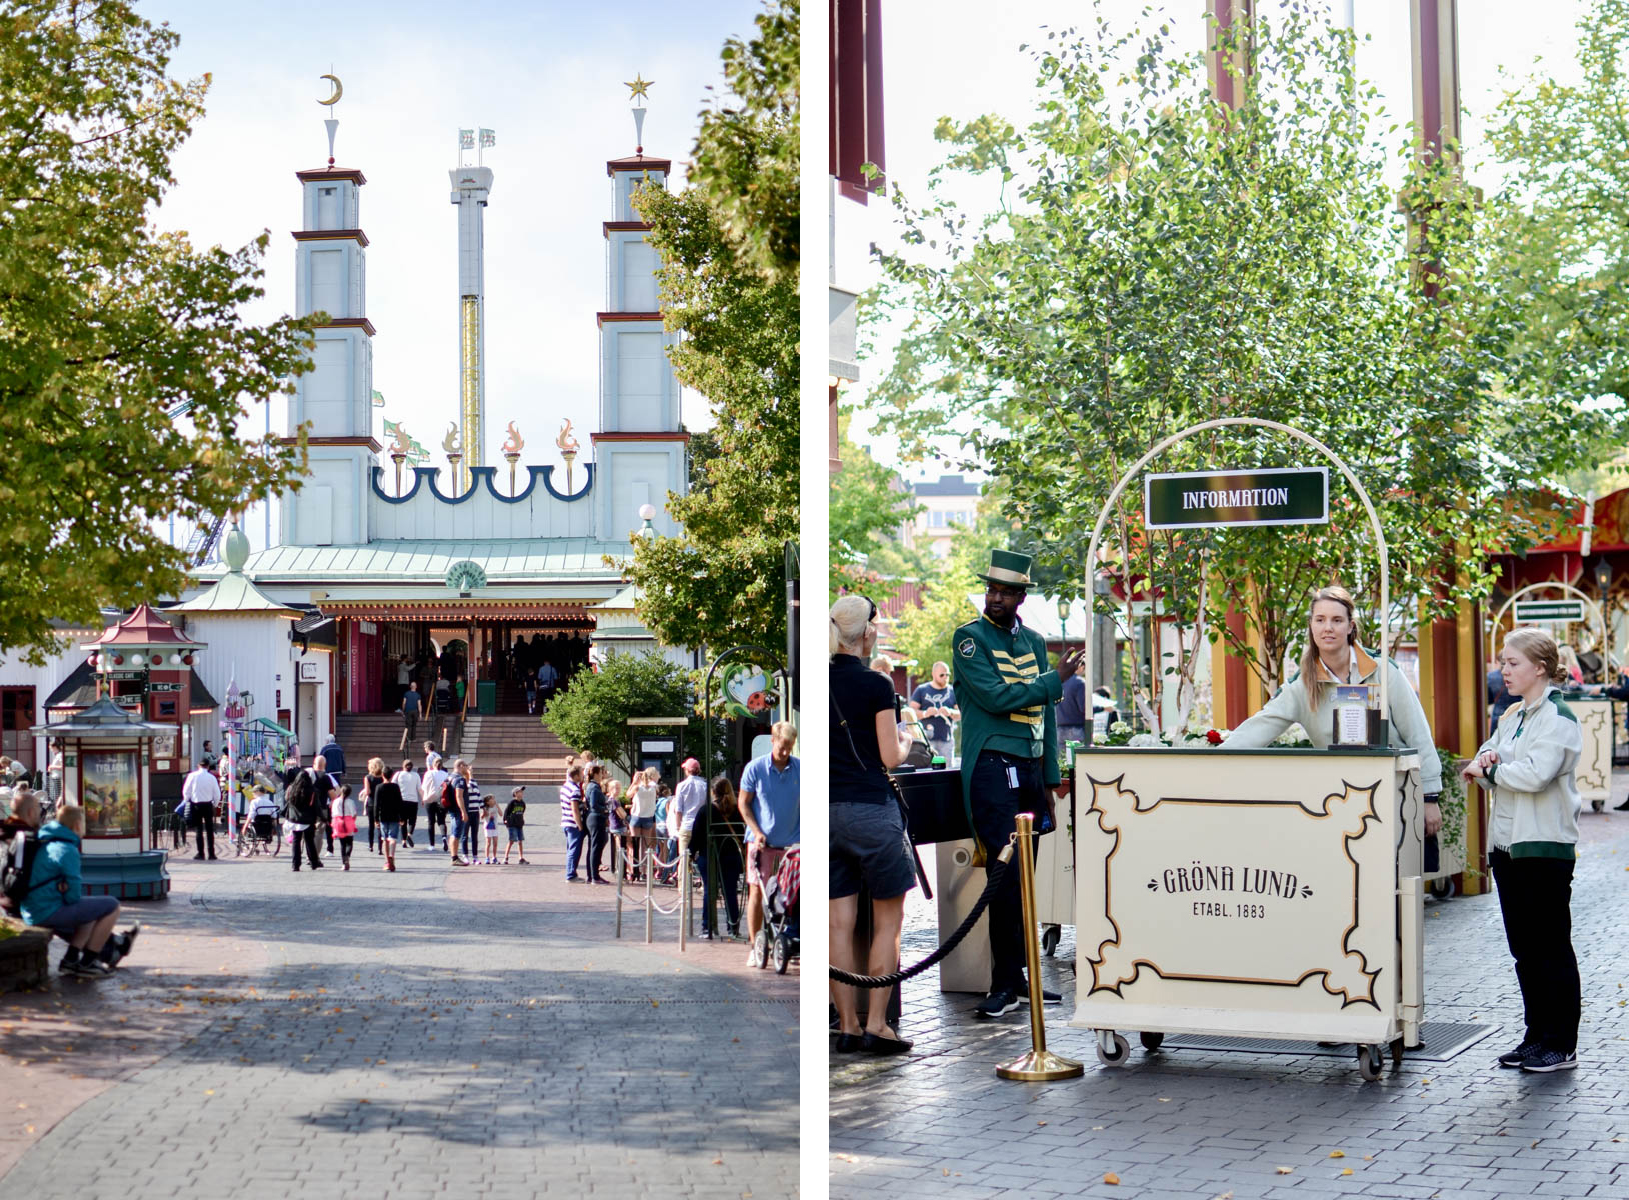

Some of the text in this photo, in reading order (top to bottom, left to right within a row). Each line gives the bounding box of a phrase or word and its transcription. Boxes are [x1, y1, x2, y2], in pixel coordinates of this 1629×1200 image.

[1183, 488, 1289, 510] INFORMATION
[1163, 860, 1298, 899] GRÖNA LUND
[1193, 902, 1265, 919] ETABL. 1883
